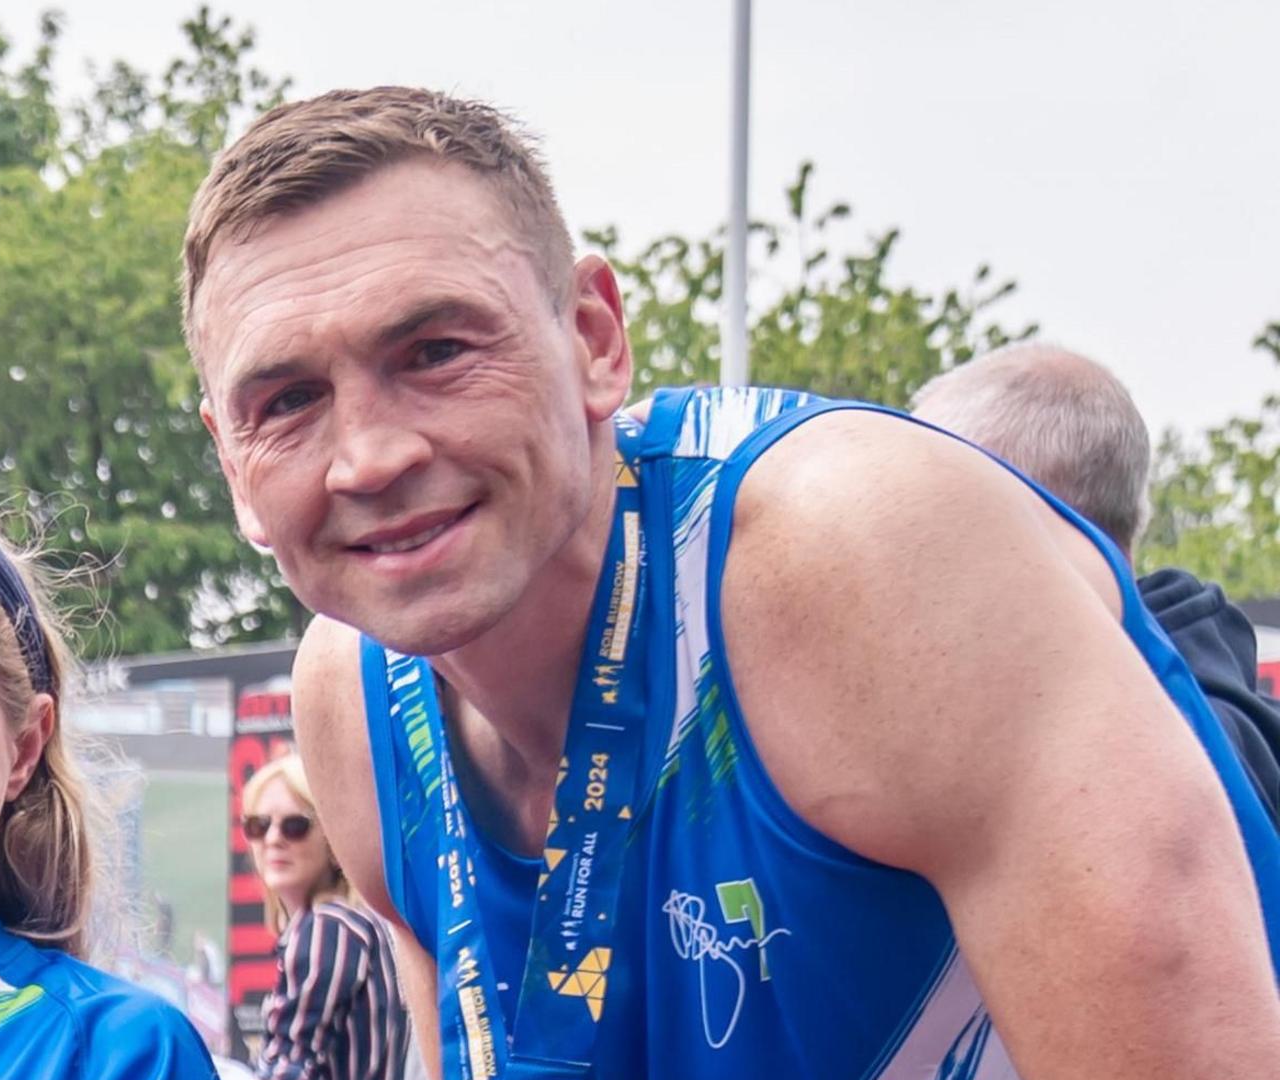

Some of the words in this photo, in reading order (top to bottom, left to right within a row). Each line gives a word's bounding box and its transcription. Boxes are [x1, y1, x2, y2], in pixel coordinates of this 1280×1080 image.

[584, 753, 609, 811] 2024
[582, 831, 598, 855] ALL
[448, 850, 464, 908] 2024
[576, 858, 592, 886] FOR
[571, 887, 587, 919] RUN
